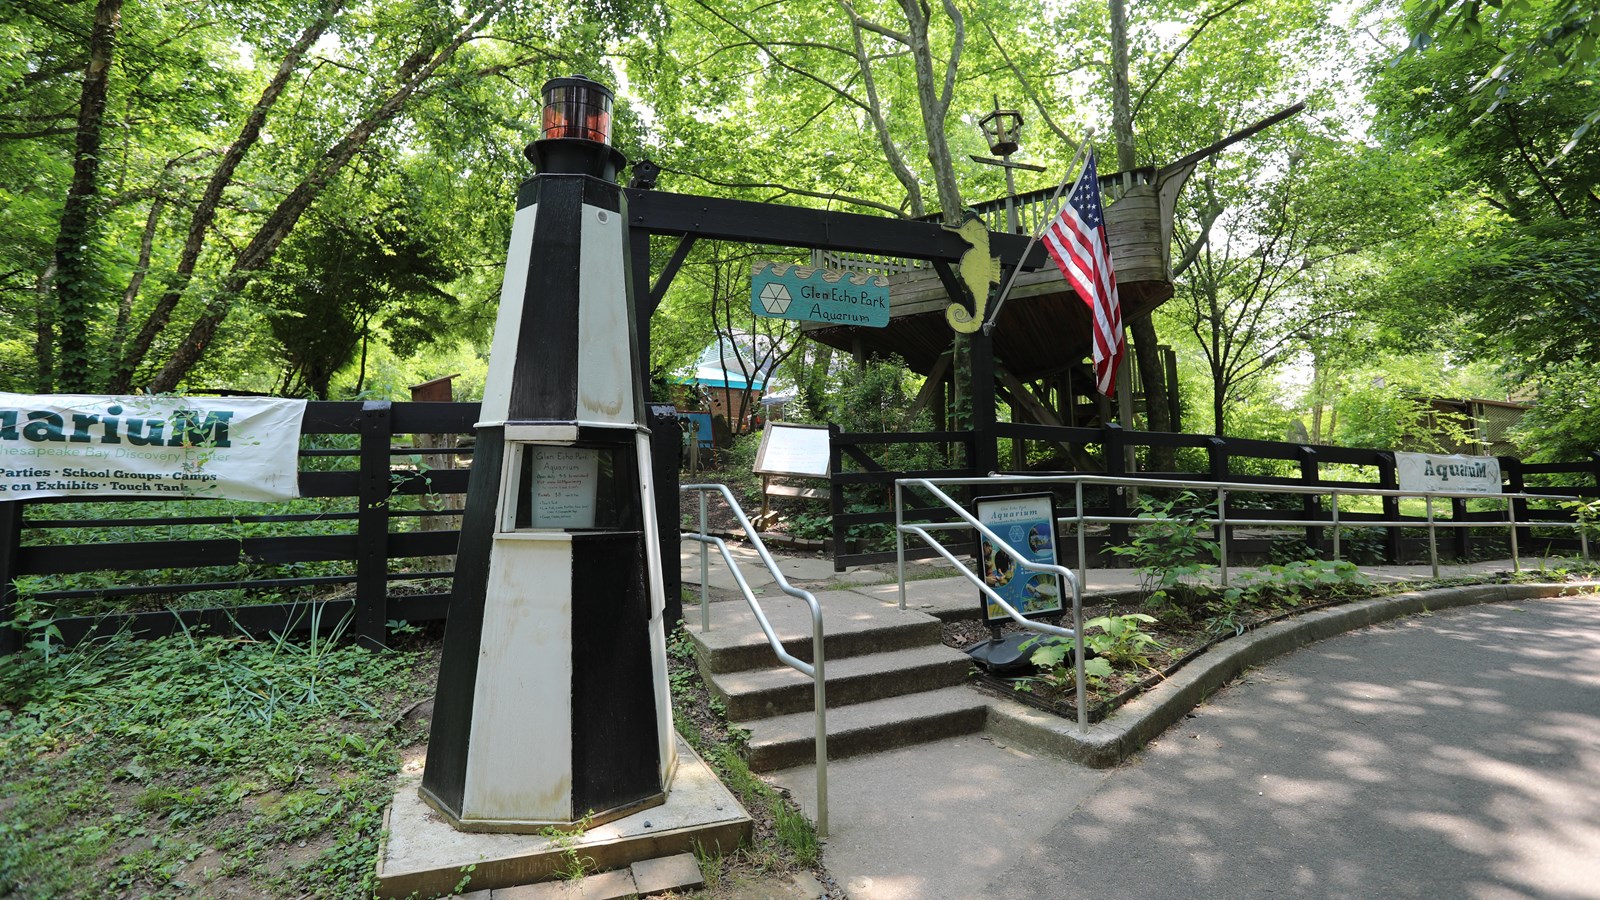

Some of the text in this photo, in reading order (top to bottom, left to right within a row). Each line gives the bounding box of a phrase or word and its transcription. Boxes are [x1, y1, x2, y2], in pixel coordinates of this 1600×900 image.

[800, 285, 886, 309] Glen Echo Park
[809, 303, 870, 322] Aquarium
[85, 446, 110, 460] Bay
[115, 447, 181, 462] Discovery
[62, 467, 110, 478] School
[113, 469, 162, 481] Groups
[172, 471, 217, 483] Camps
[11, 483, 32, 492] on
[36, 480, 99, 491] Exhibits
[110, 481, 151, 491] Touch
[991, 509, 1038, 520] Aquarium
